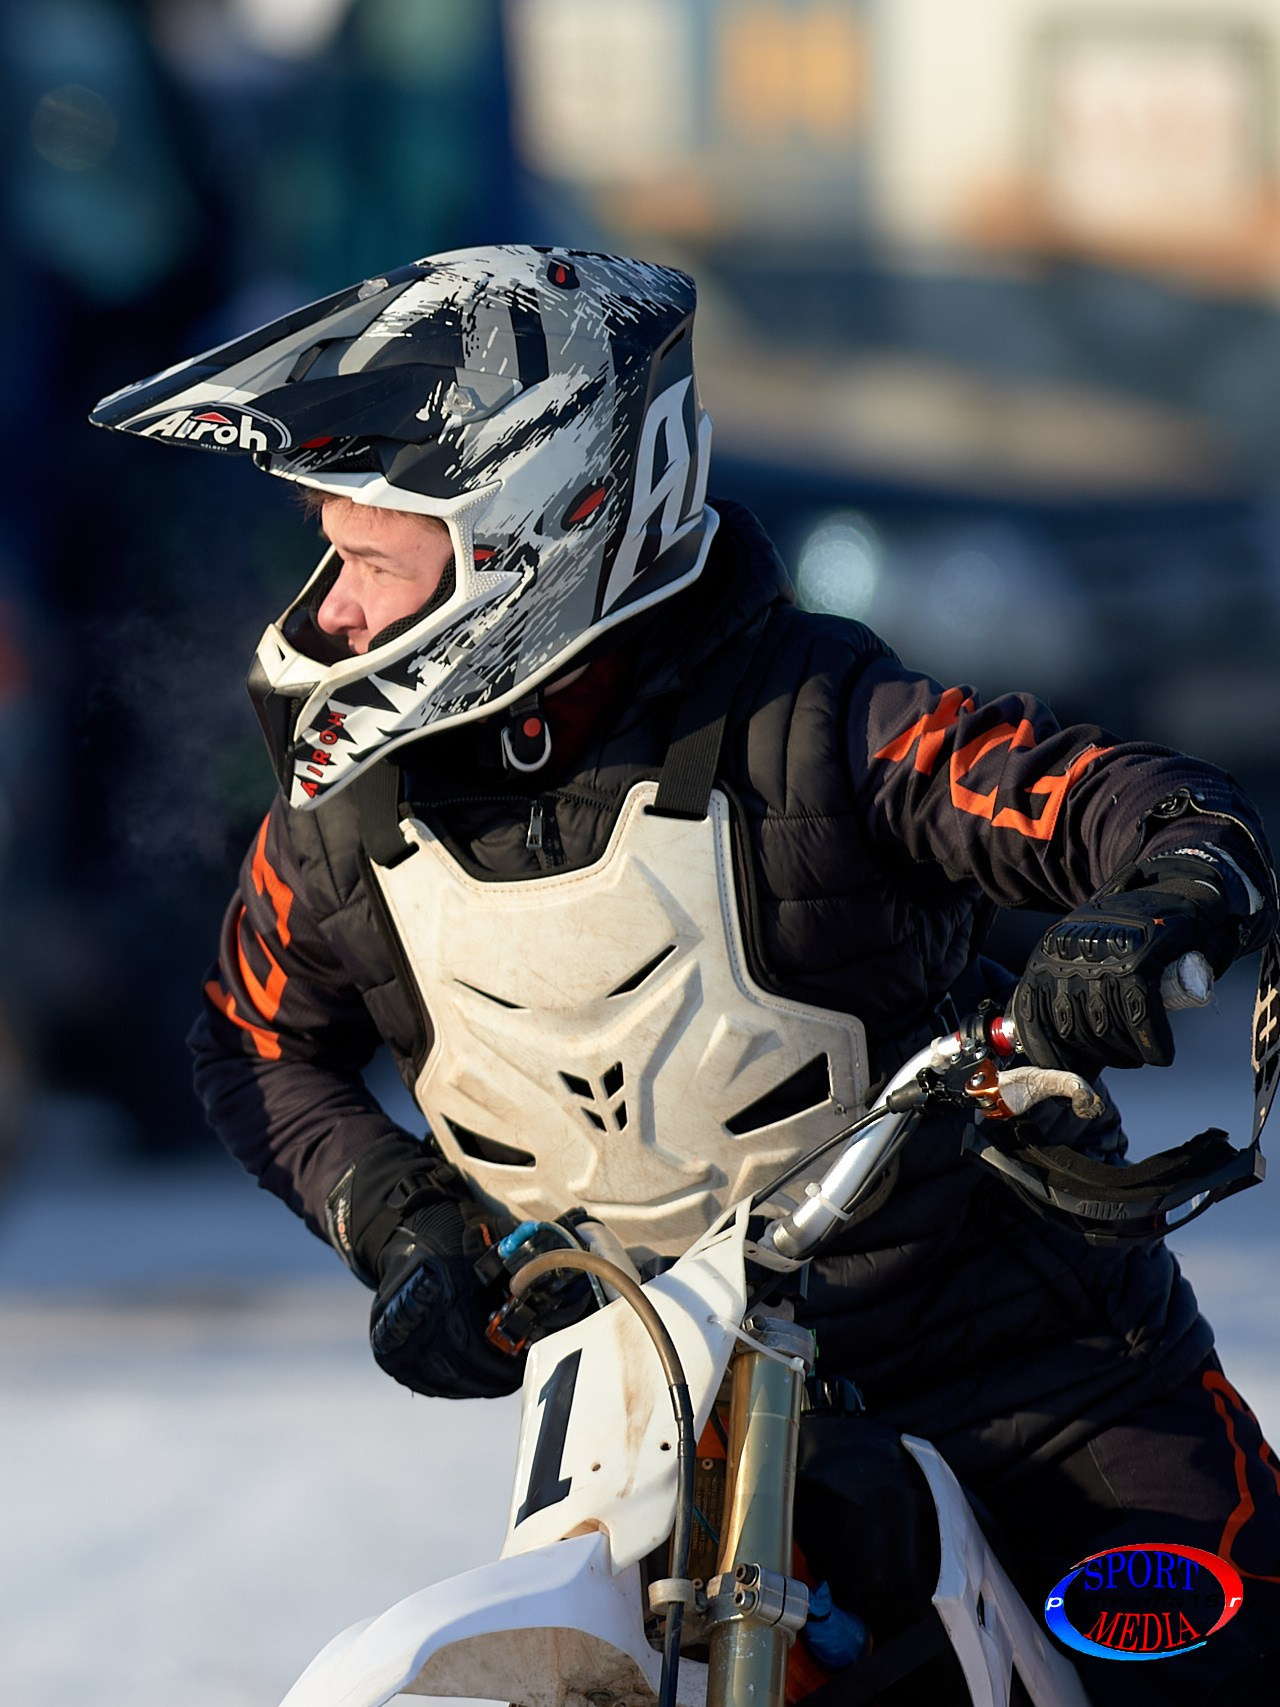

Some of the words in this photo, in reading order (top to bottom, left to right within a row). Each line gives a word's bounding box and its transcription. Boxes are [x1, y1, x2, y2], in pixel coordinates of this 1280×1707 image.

[139, 409, 268, 451] Airoh
[300, 711, 347, 798] AIROH
[514, 1348, 583, 1530] 1
